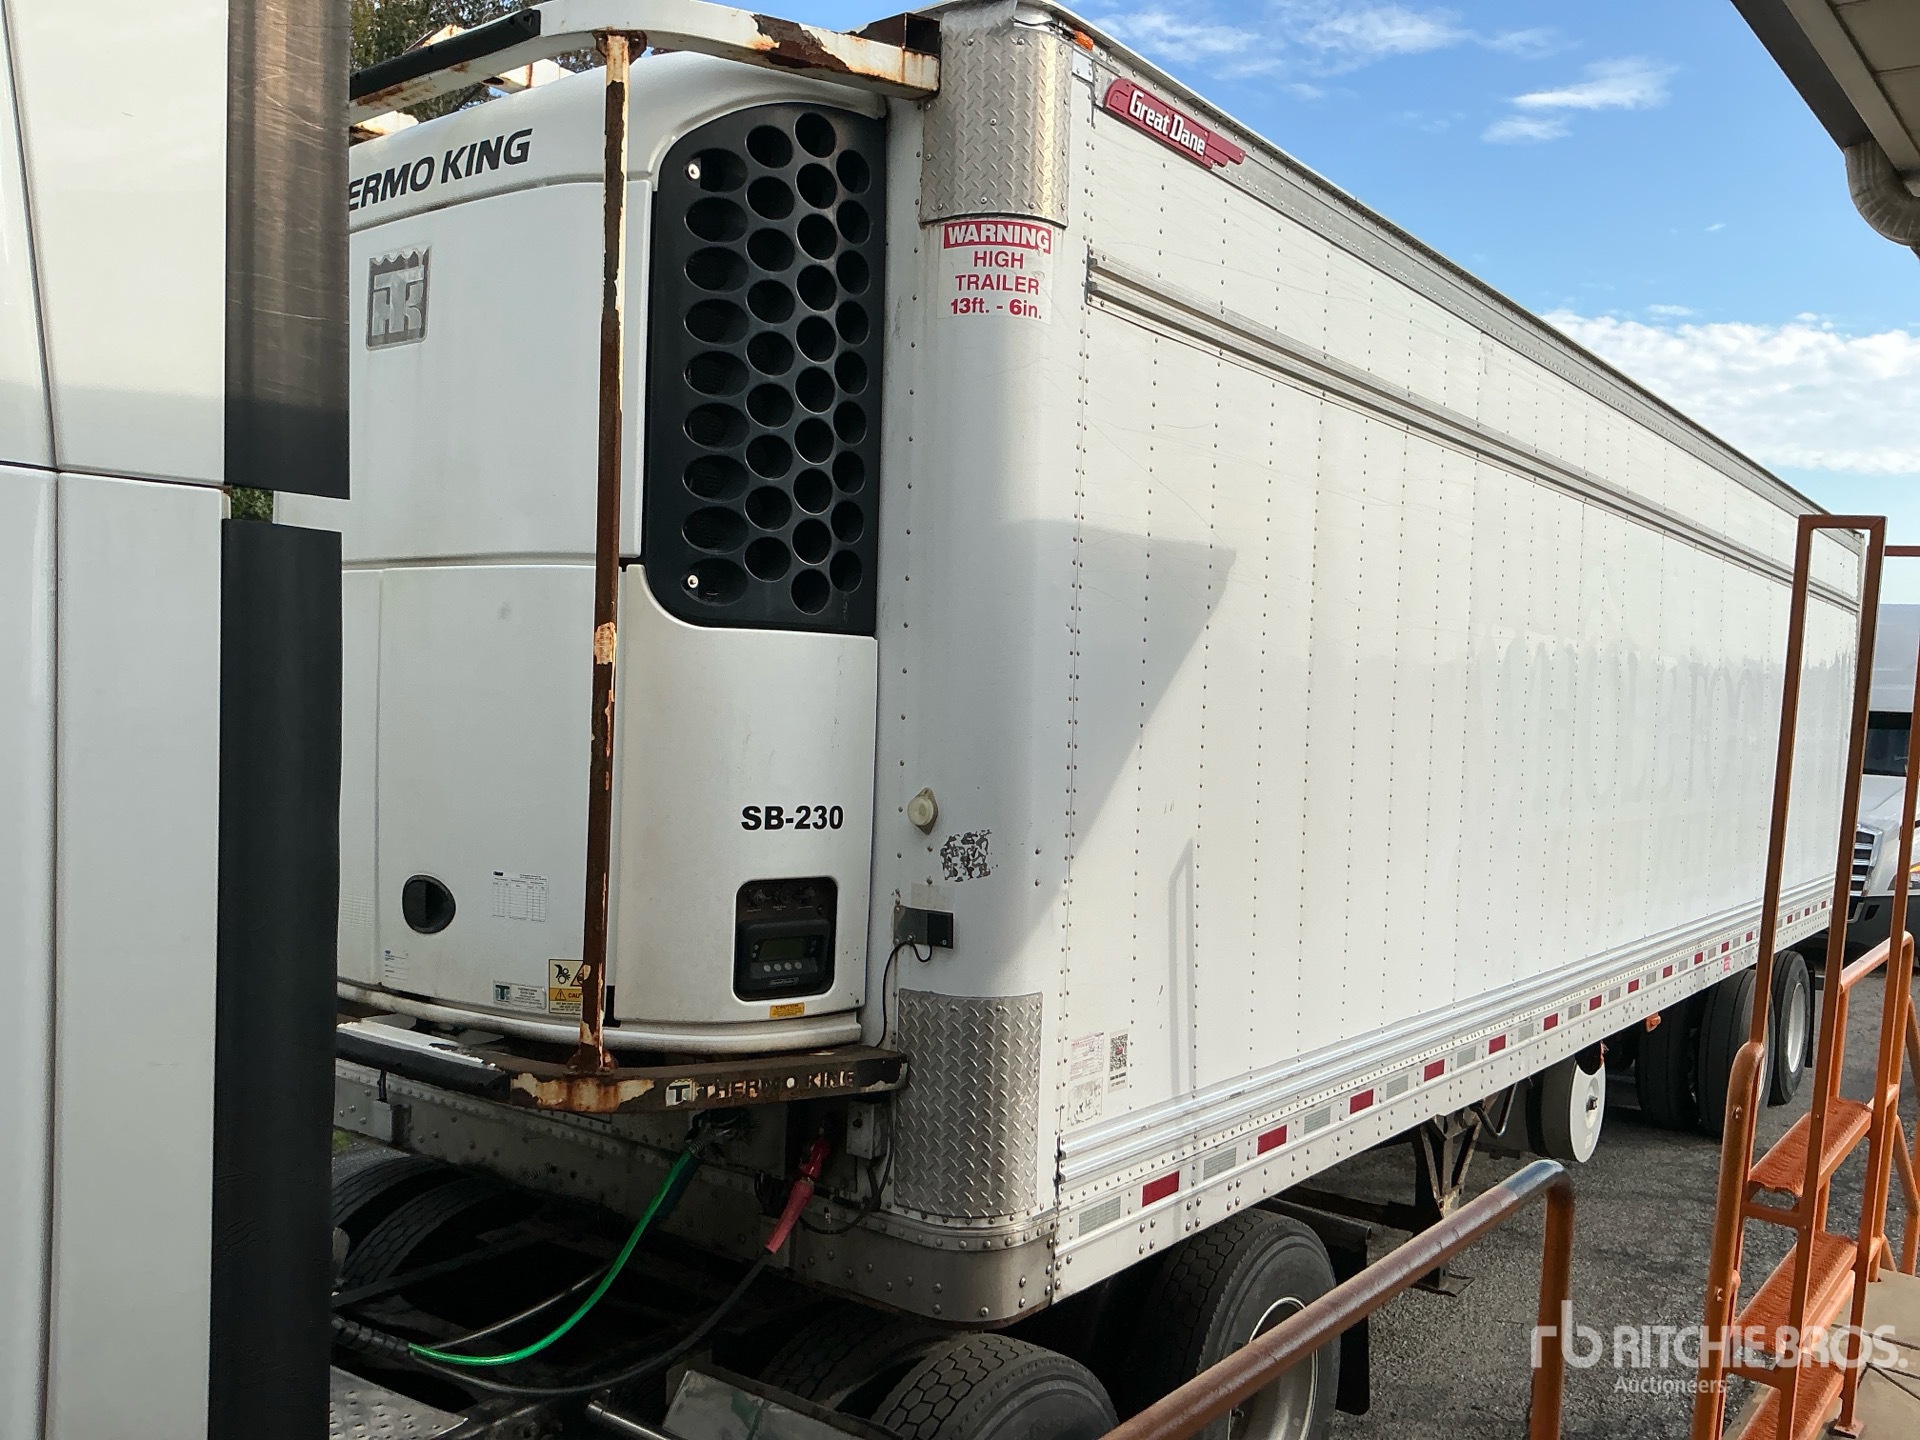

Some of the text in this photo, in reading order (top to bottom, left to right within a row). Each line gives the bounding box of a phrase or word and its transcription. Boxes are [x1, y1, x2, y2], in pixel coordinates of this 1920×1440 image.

[1129, 89, 1206, 157] Great Dane
[441, 128, 533, 184] KING
[947, 224, 1052, 253] WARNING
[972, 250, 1024, 270] HIGH
[955, 274, 1040, 295] TRAILER
[950, 298, 990, 315] 13ft.
[1009, 298, 1042, 319] 6in.
[741, 805, 844, 831] SB-230
